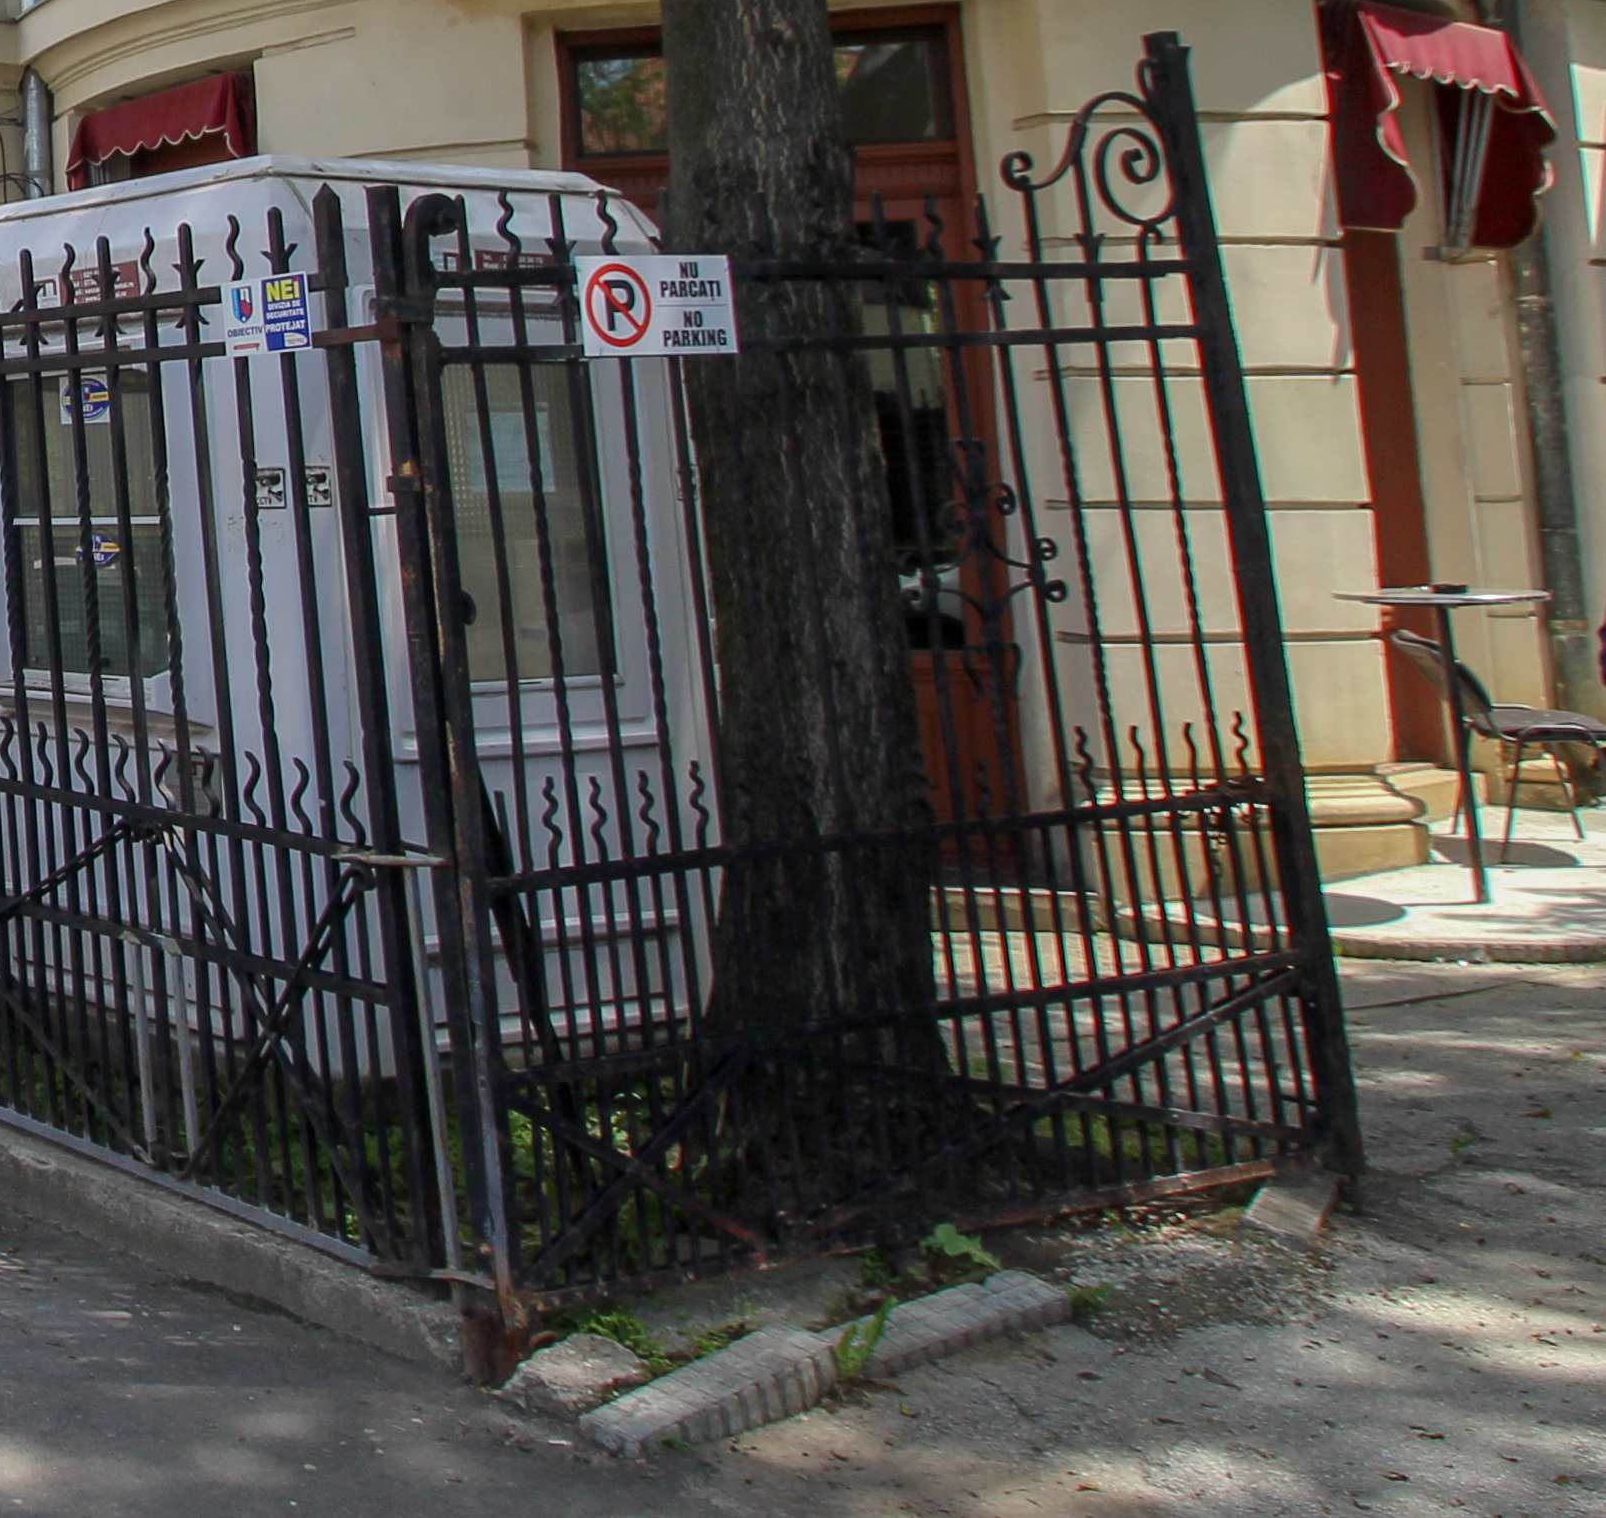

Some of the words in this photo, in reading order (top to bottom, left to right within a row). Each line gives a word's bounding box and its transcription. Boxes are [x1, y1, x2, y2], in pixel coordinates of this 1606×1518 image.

[679, 262, 699, 278] NU
[264, 320, 306, 333] PROTEJAT
[683, 310, 703, 328] NO
[227, 325, 263, 338] OBIECTIV
[663, 329, 727, 347] PARKING
